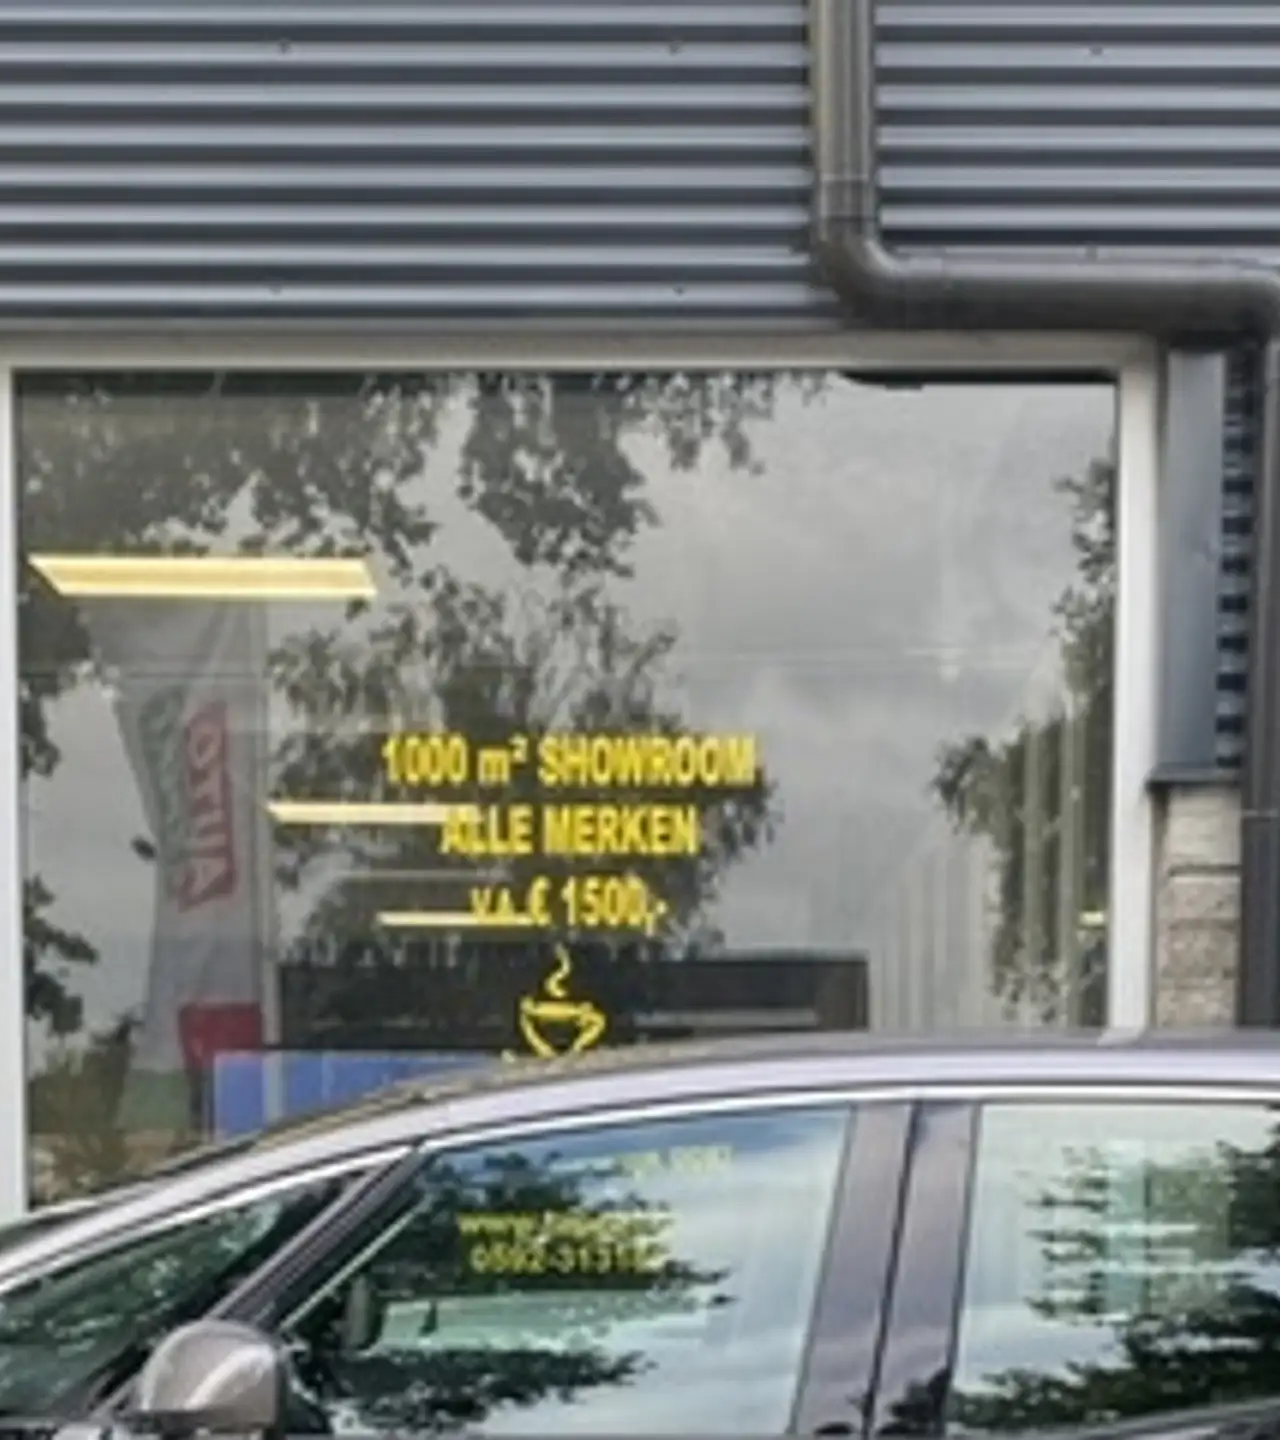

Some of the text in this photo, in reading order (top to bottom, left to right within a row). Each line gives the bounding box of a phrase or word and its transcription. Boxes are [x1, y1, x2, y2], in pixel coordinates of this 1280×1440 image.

[382, 734, 468, 785] 1000
[538, 734, 756, 786] SHOWROOM
[441, 804, 698, 854] ALLE MERKEN
